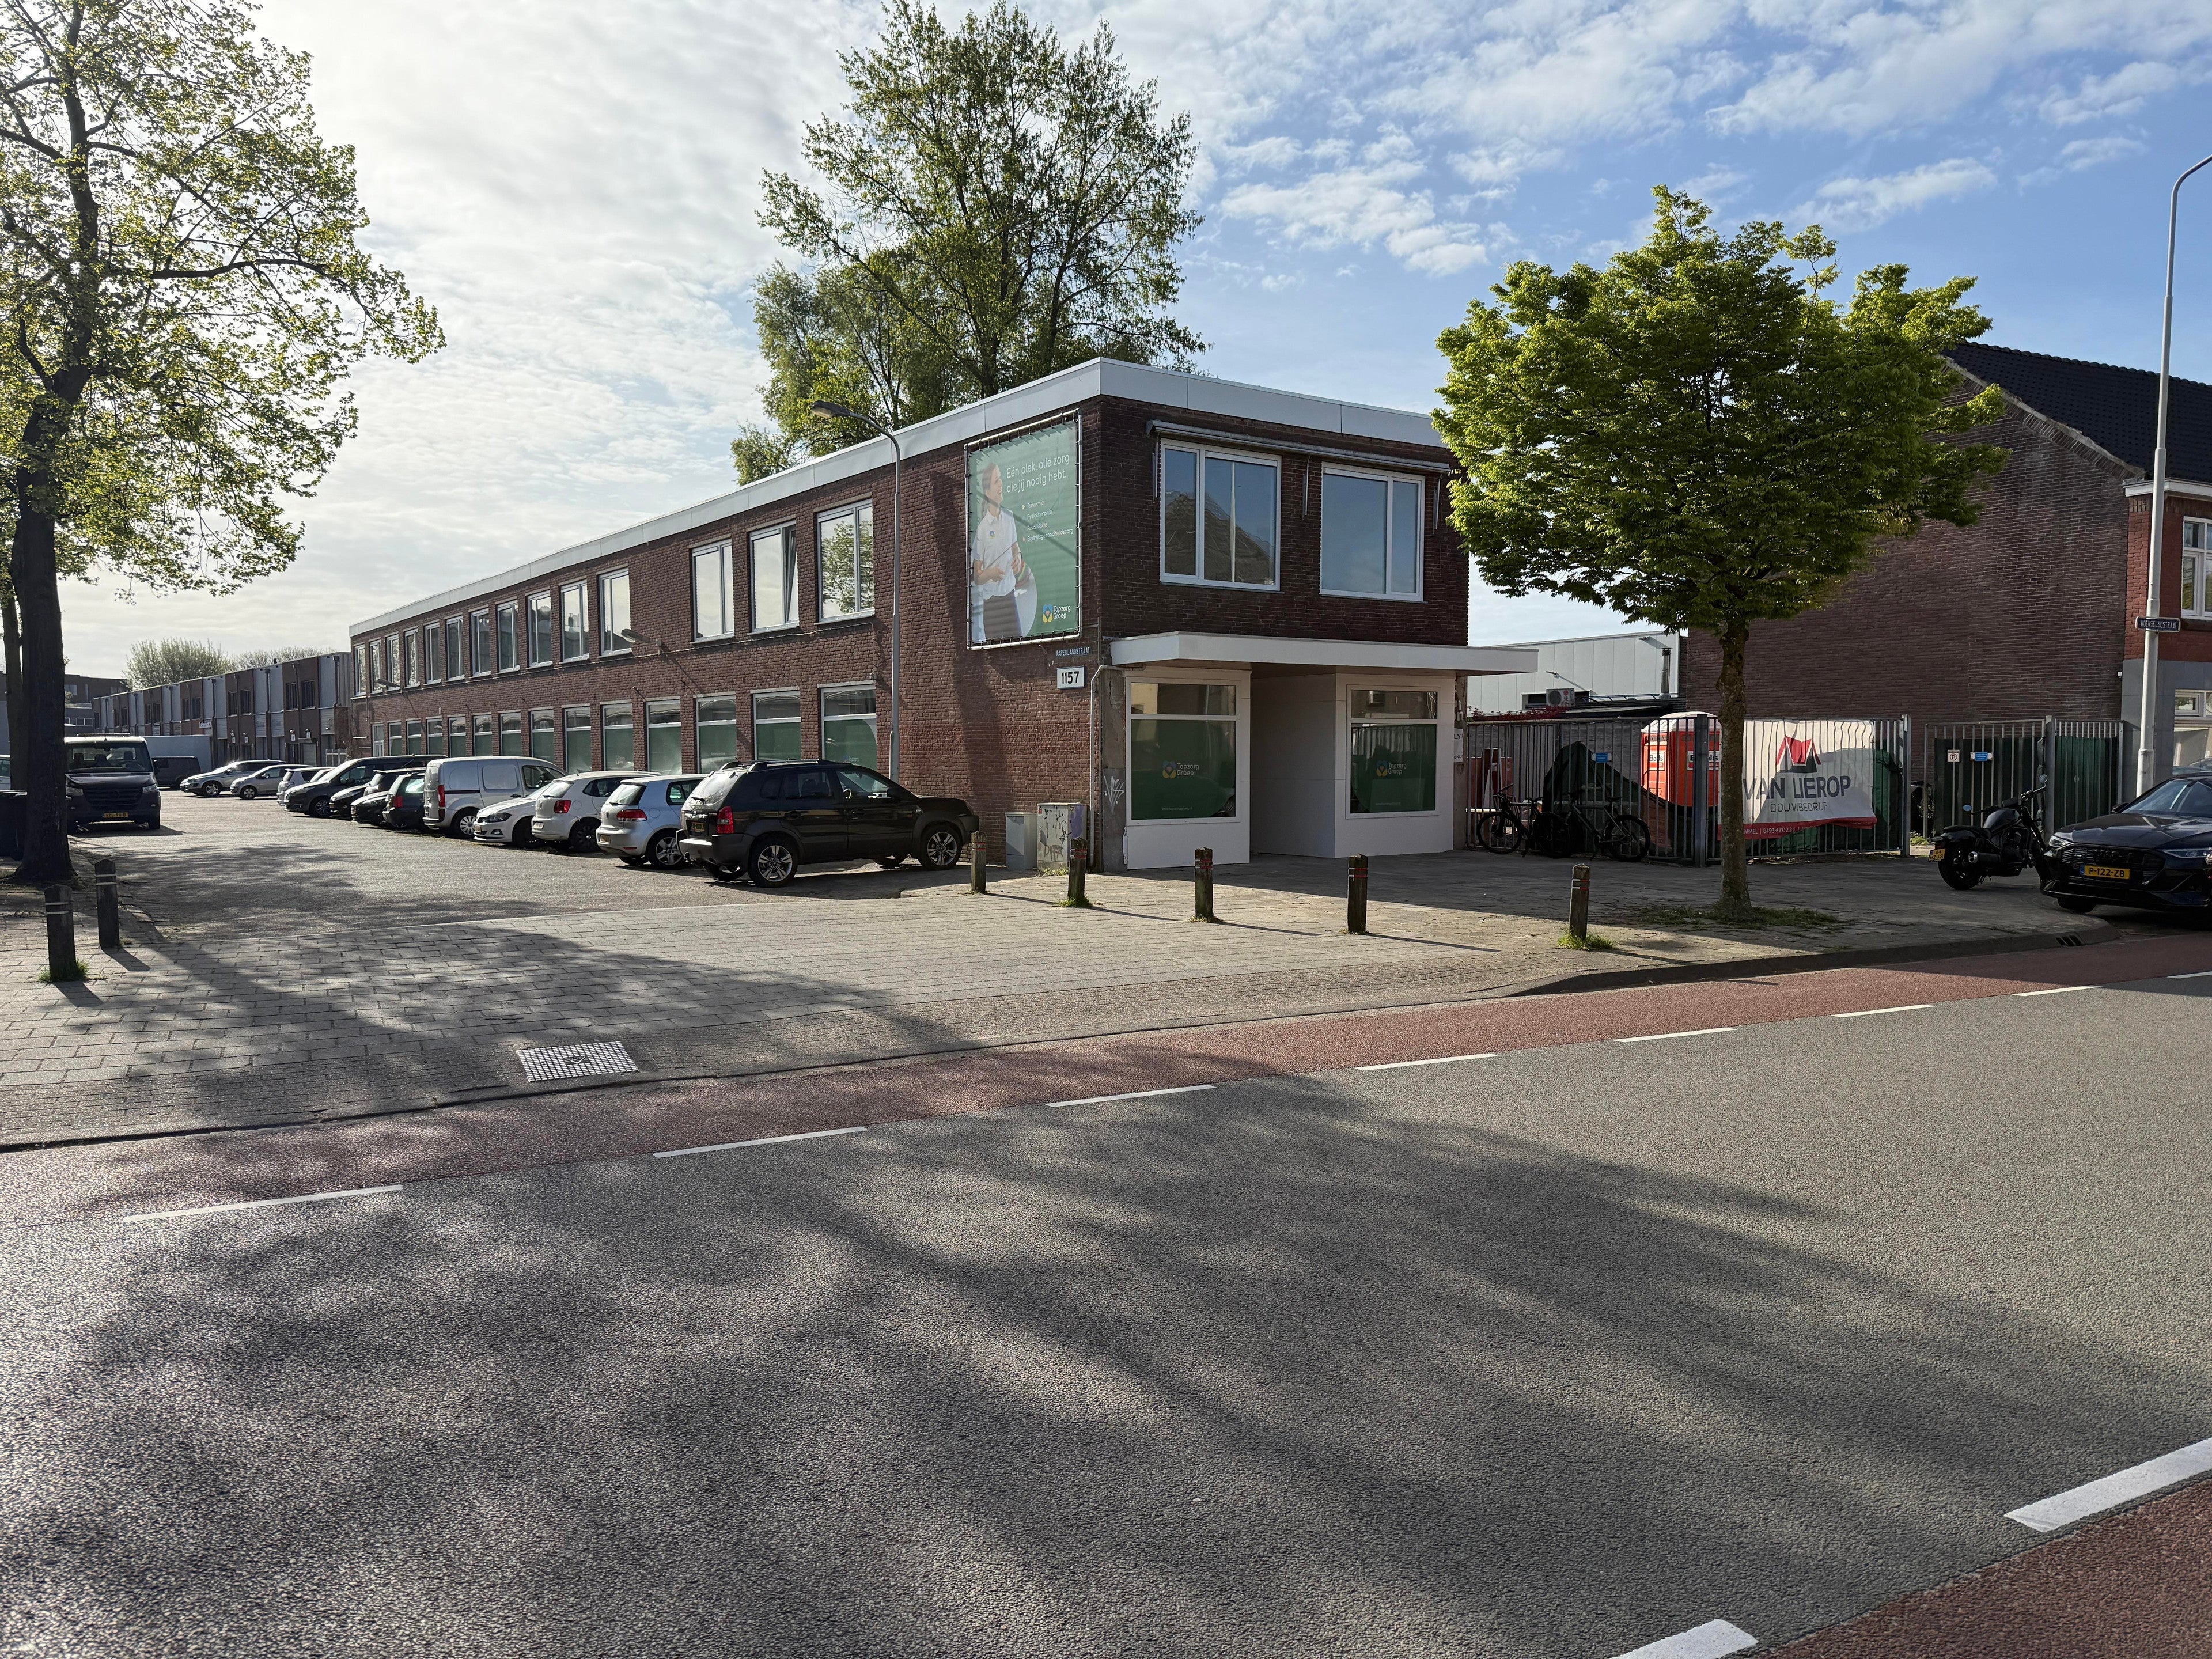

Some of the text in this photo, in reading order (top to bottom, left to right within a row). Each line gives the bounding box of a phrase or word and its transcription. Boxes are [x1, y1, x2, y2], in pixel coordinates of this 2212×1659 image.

[1006, 454, 1070, 478] Eén plek, alle zorg
[1006, 482, 1017, 493] die
[1027, 474, 1047, 486] nodig
[1048, 469, 1067, 482] hebt.
[1053, 605, 1071, 613] Topzorg
[2140, 620, 2177, 628] WOENSELSESTRAAT
[1056, 647, 1090, 656] RAPENLANDSTRAAT
[1062, 671, 1080, 684] 1157
[1177, 763, 1199, 771] Topzorg
[1743, 775, 1851, 800] VAN LIEROP
[2089, 867, 2125, 877] P-122-ZB
